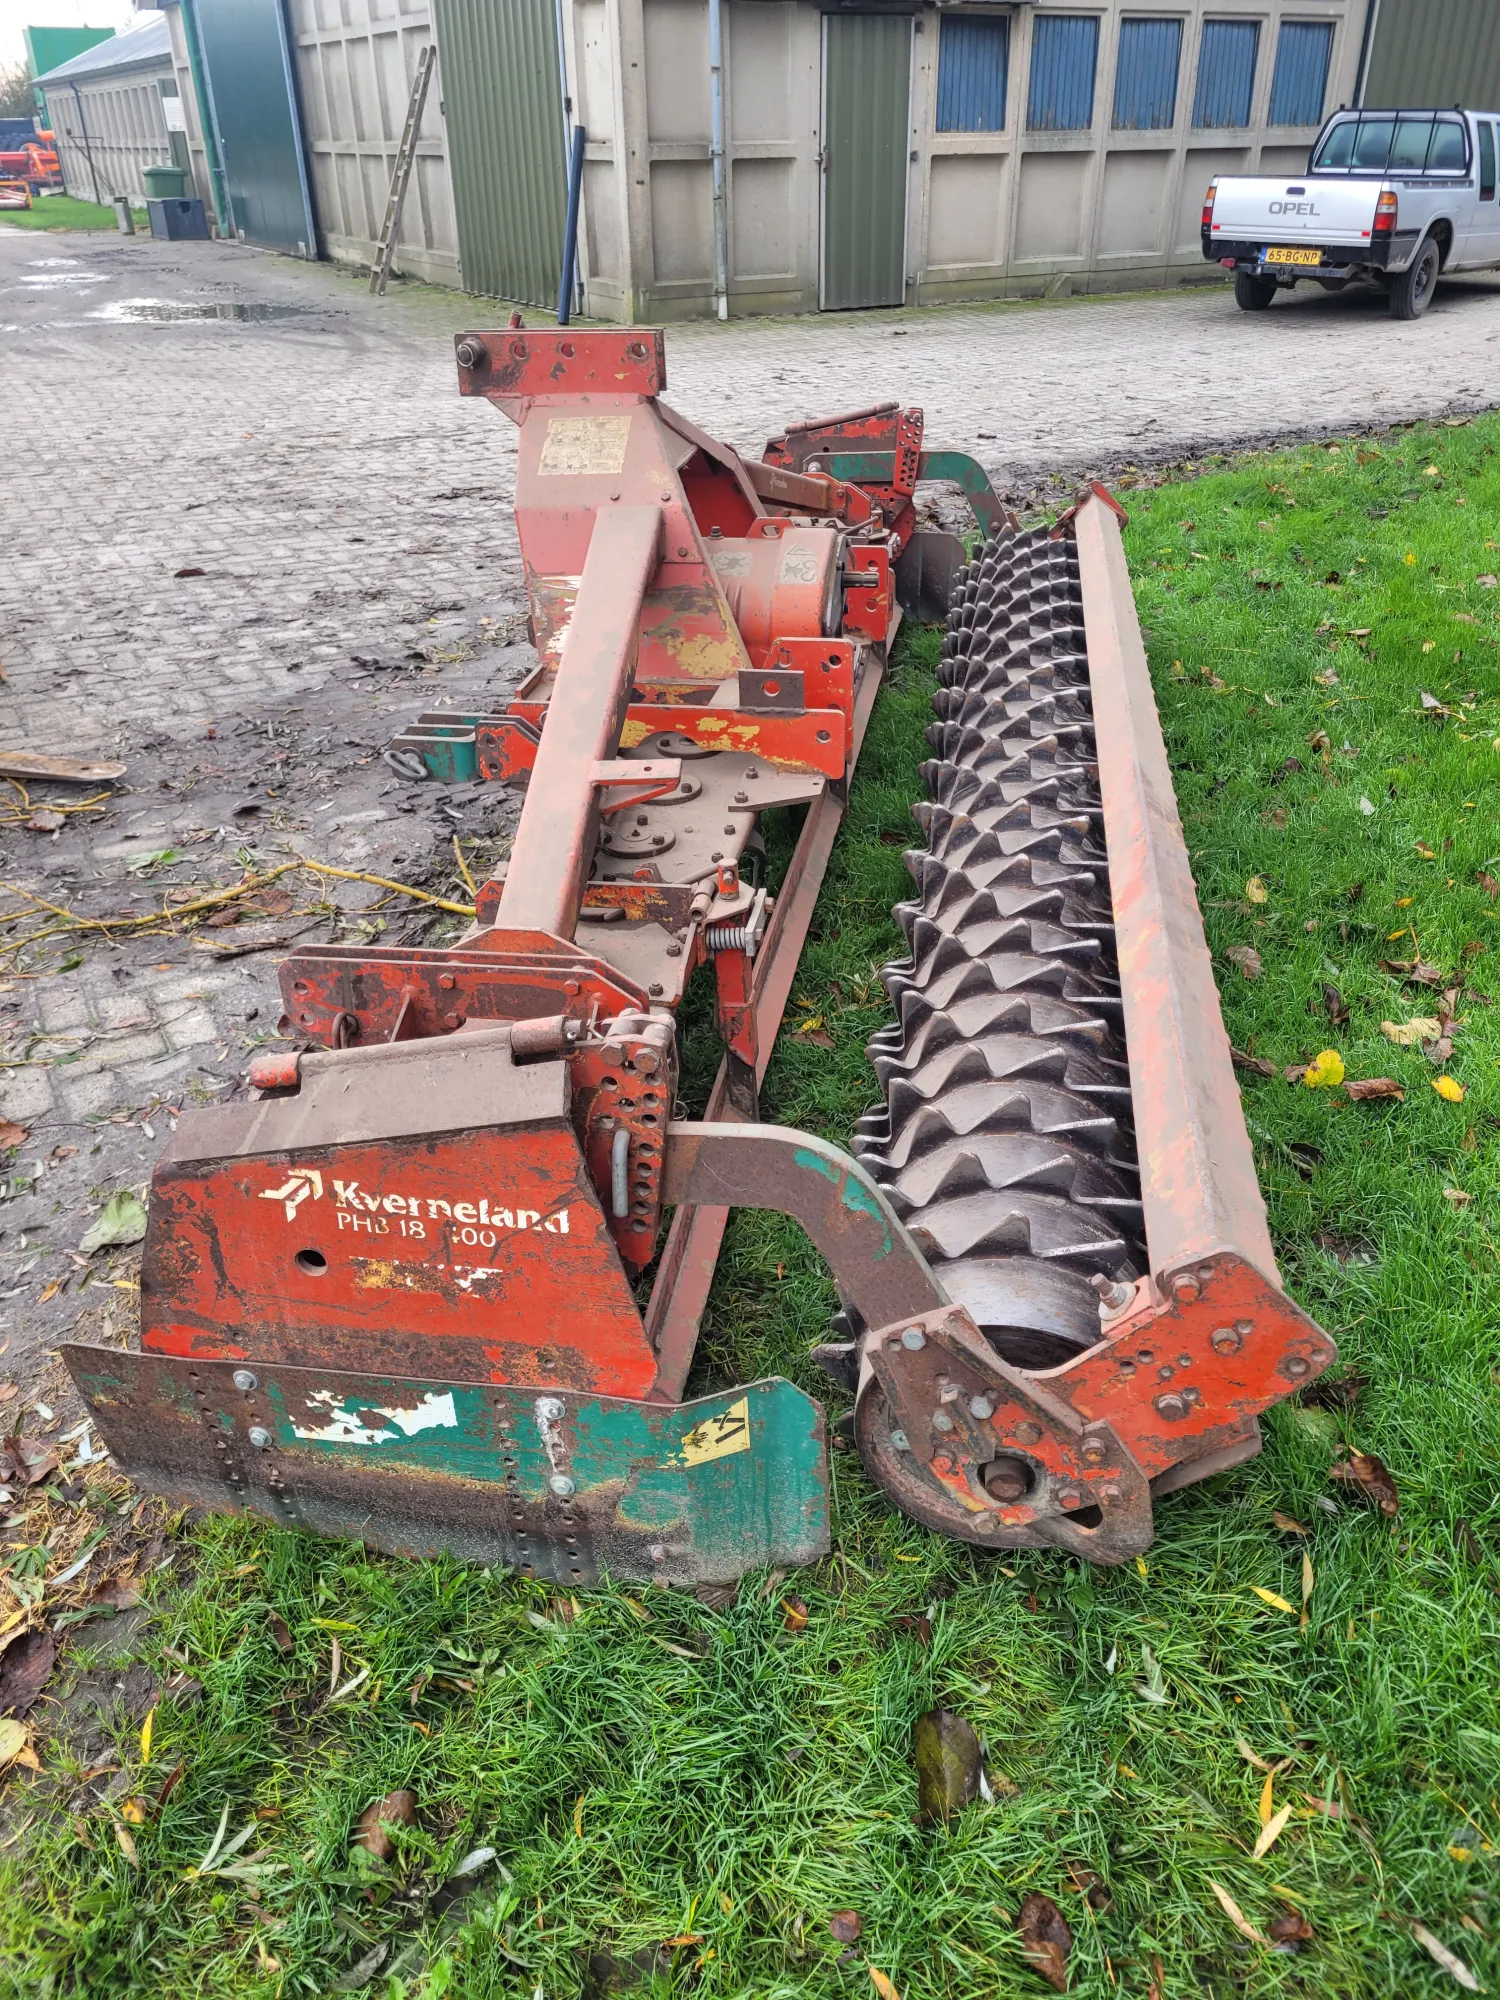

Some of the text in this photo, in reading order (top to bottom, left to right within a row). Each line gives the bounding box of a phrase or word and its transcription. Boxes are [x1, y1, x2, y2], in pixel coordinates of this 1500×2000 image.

[1268, 202, 1320, 216] OPEL
[1268, 250, 1318, 263] 65-BG-NP
[332, 1179, 570, 1234] Kverneland
[336, 1211, 390, 1234] PHB
[399, 1218, 426, 1239] 18
